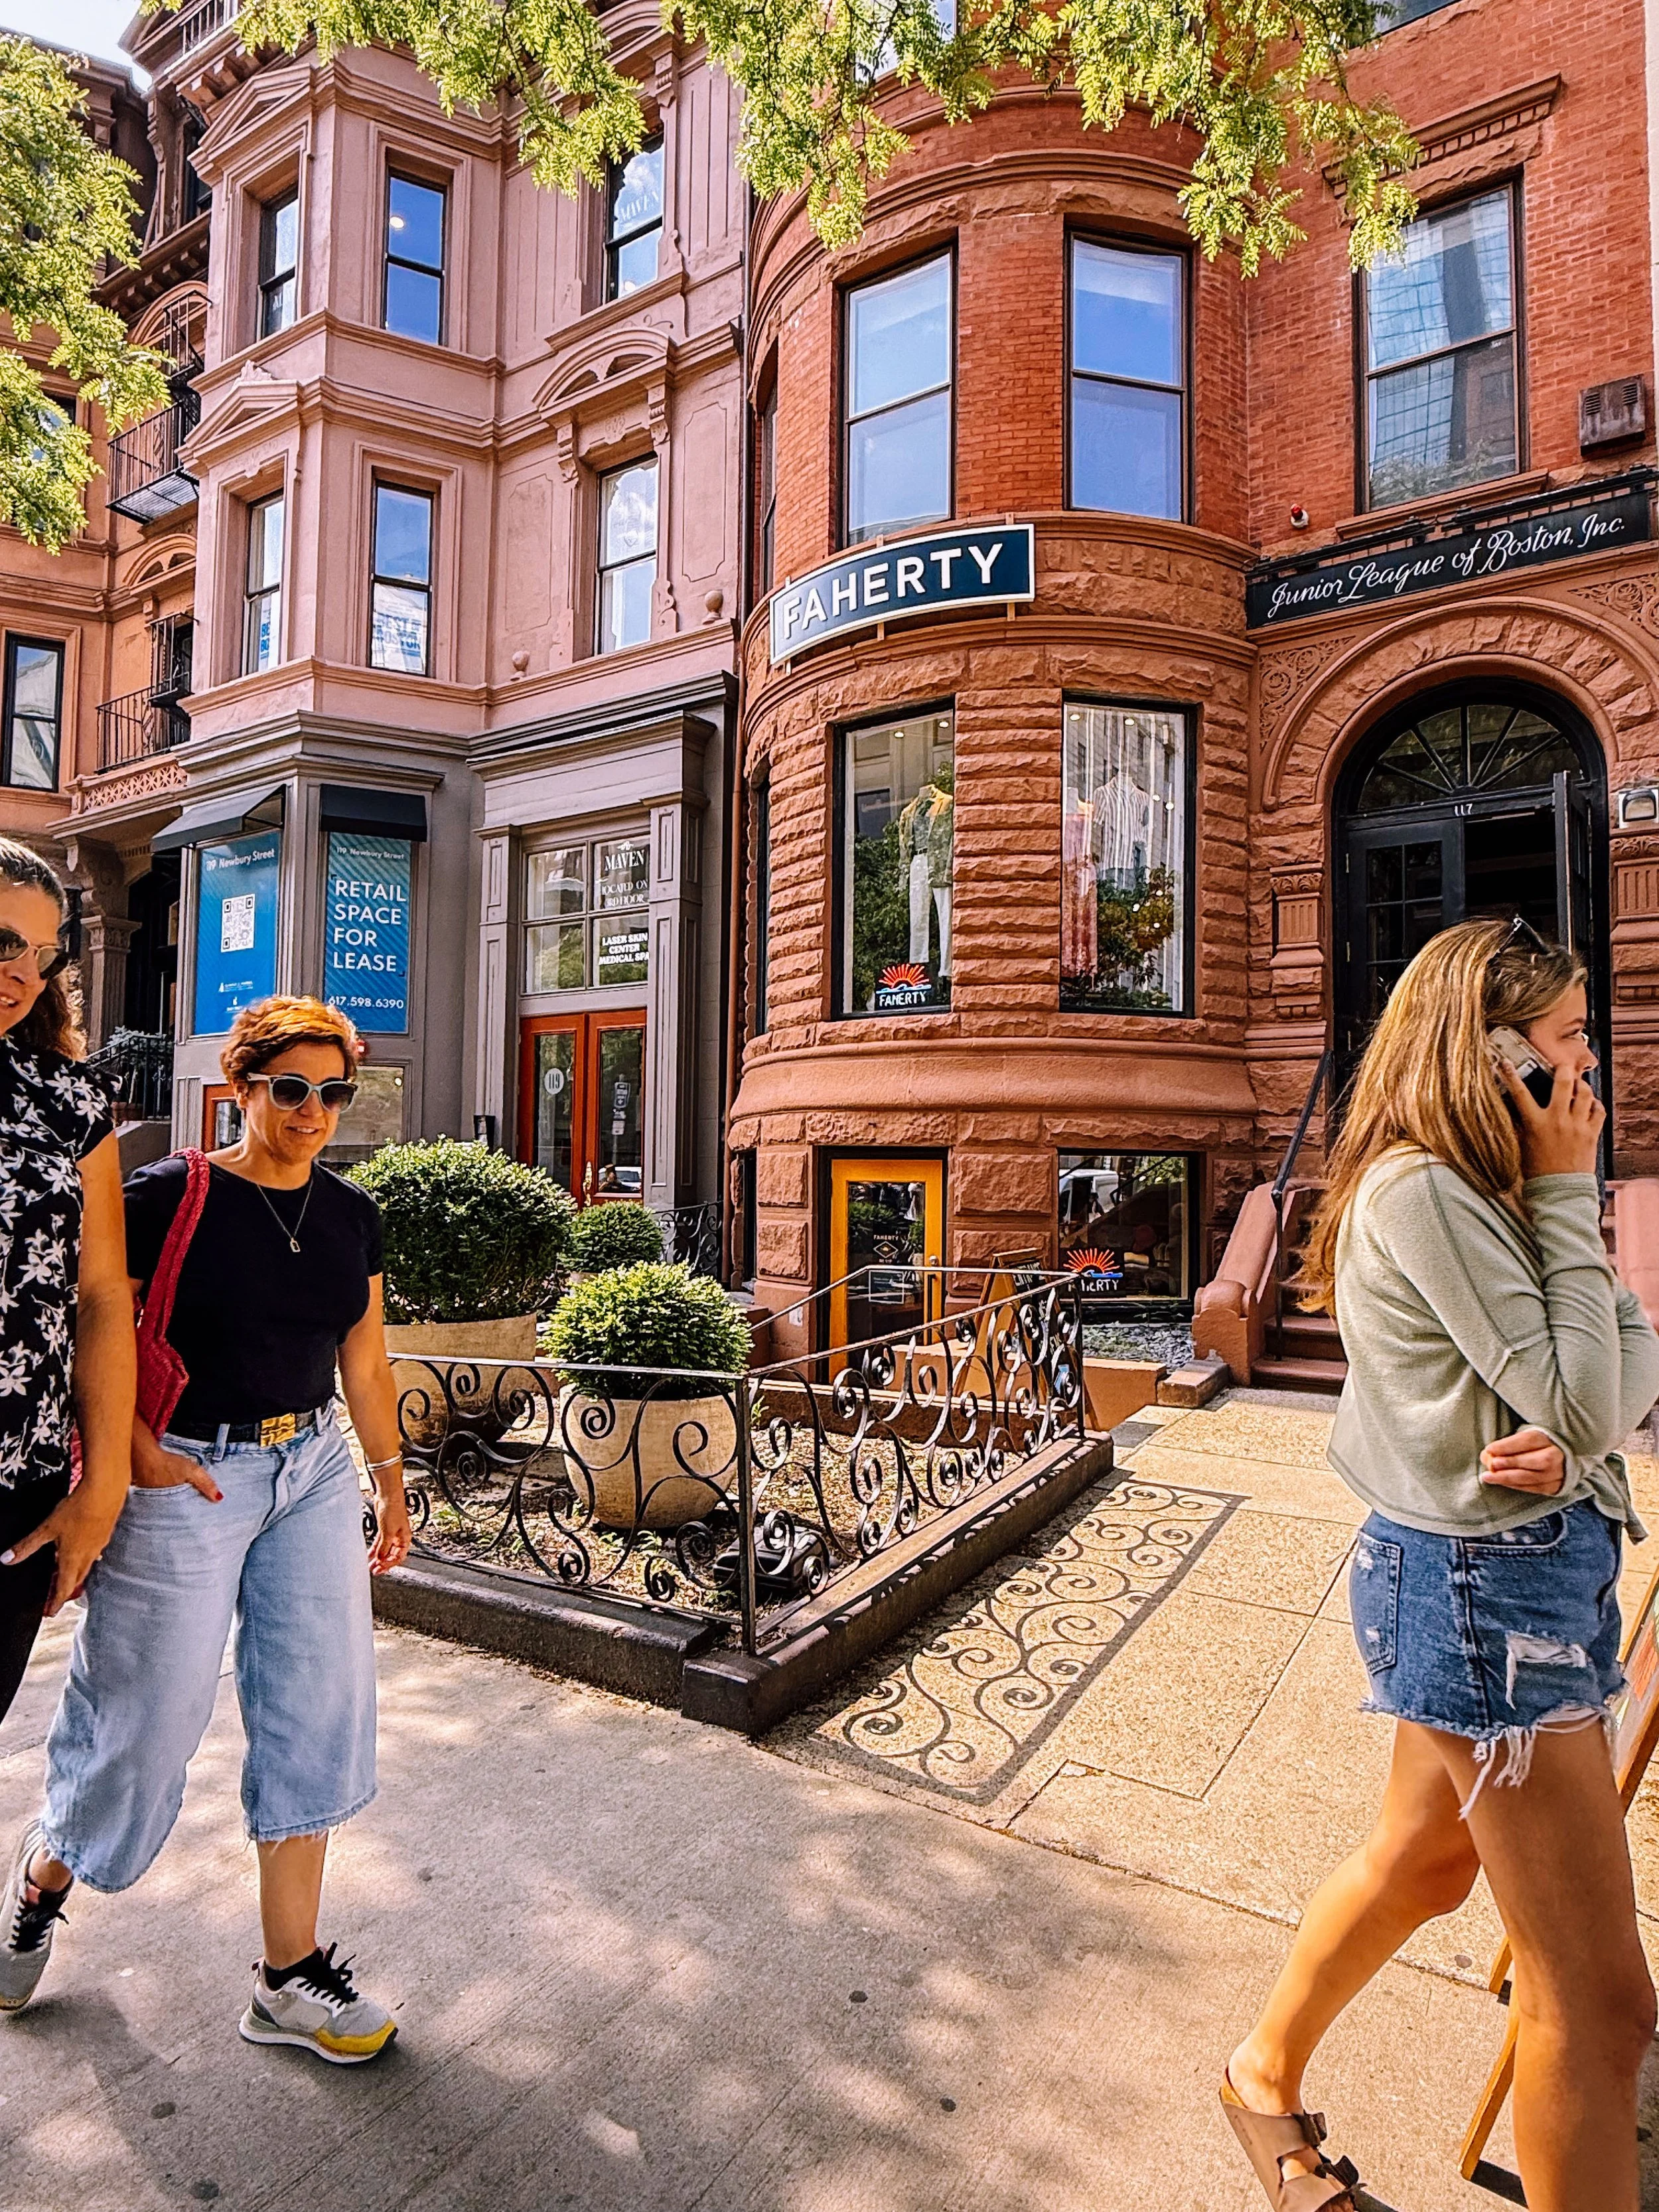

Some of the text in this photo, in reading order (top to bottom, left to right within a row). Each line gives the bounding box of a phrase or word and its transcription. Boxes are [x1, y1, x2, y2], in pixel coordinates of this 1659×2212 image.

[1267, 579, 1343, 618] Junior
[1338, 555, 1444, 603] League
[1452, 538, 1482, 575] of
[1577, 513, 1625, 548] Inc.
[782, 543, 1003, 640] FAHERTY
[1454, 803, 1473, 816] 117
[219, 854, 252, 869] Newbury
[252, 848, 275, 861] Street
[350, 848, 382, 859] Newbury
[384, 851, 404, 859] Street
[605, 849, 645, 871] MAVEN
[334, 879, 407, 902] RETAIL
[334, 903, 402, 926] SPACE
[333, 928, 378, 948] FOR
[602, 932, 648, 946] LASER SKIN
[609, 942, 640, 954] CENTER
[333, 952, 397, 973] LEASE
[599, 951, 650, 966] MEDICAL SPA
[328, 995, 404, 1009] 617.598.6390
[879, 991, 927, 1007] FAHERTY
[549, 1073, 560, 1089] 119
[1068, 1278, 1119, 1291] FHERTY
